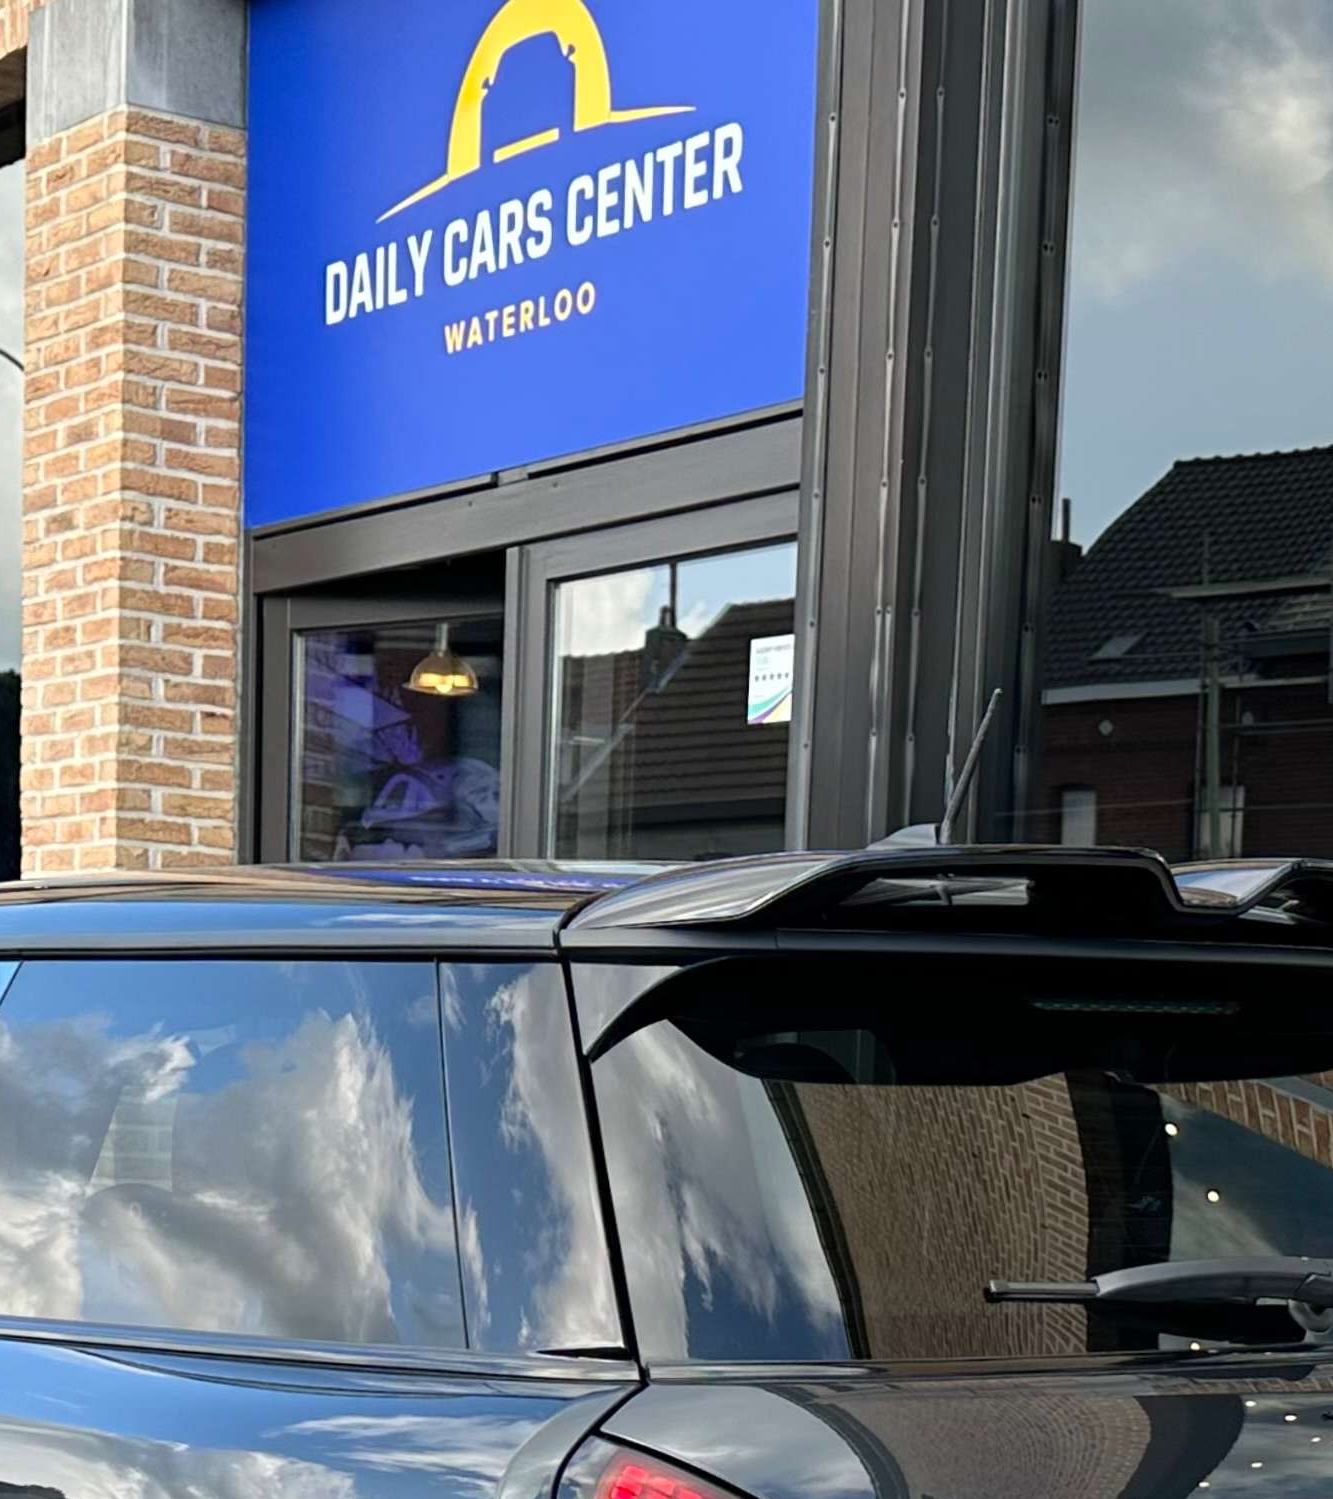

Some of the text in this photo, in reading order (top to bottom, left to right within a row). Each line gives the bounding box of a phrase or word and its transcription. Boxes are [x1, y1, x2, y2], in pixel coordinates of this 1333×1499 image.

[325, 122, 744, 325] DAILY CARS CENTER
[444, 281, 596, 353] WATERLOO
